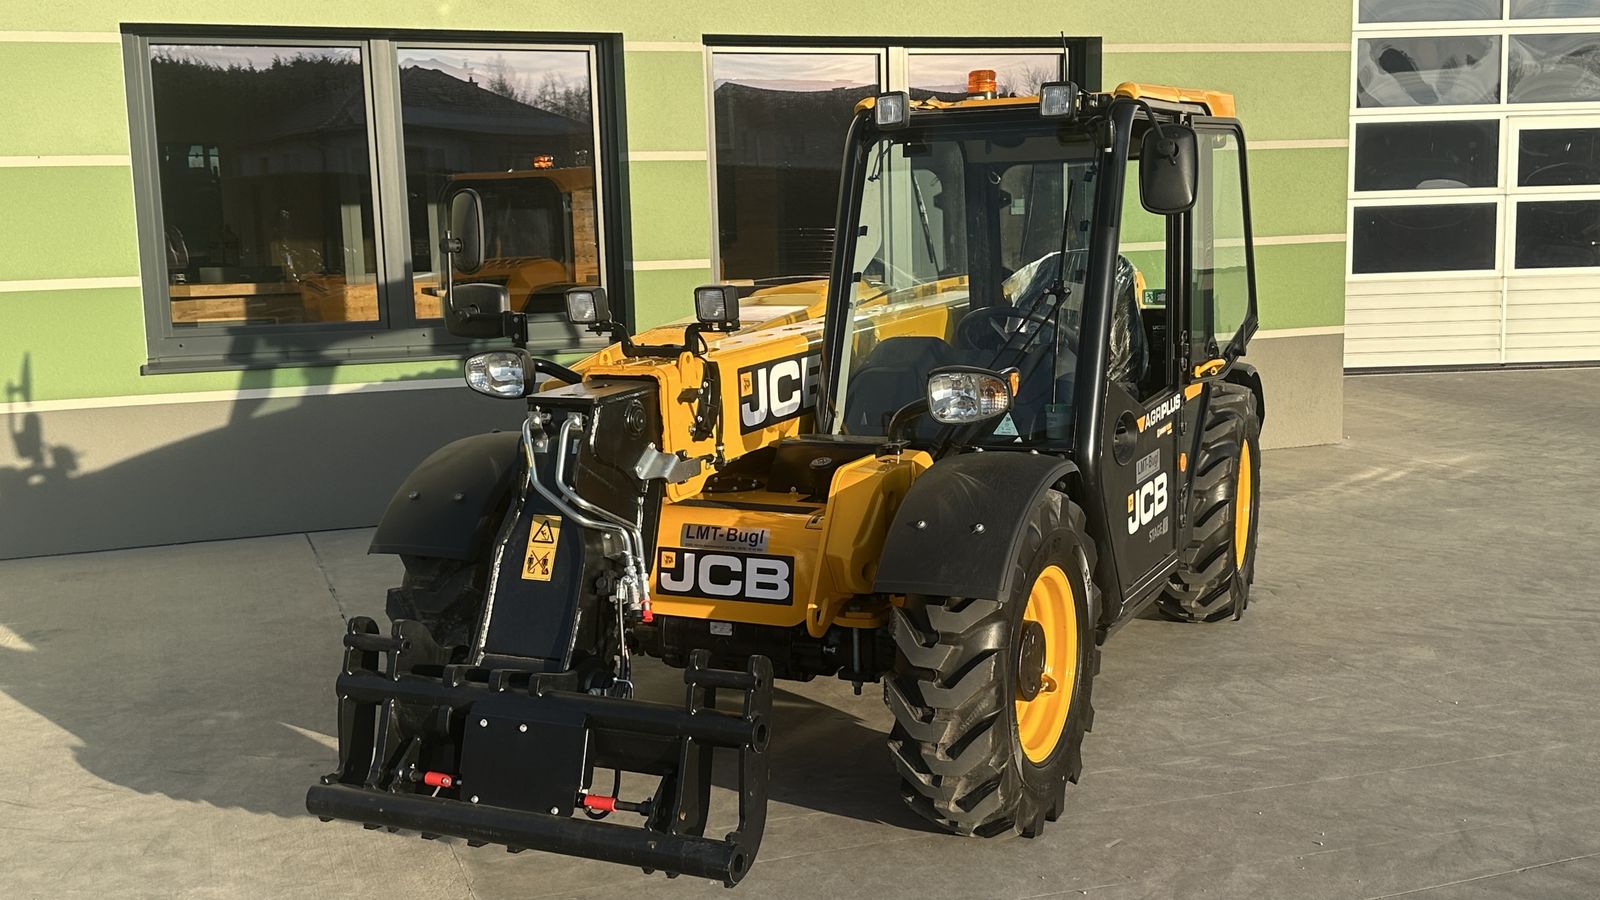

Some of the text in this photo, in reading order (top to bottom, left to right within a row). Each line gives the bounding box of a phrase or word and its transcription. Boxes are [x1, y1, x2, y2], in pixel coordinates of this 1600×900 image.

[741, 353, 820, 427] JCB
[1144, 393, 1181, 431] AGRIPLUS
[1127, 471, 1168, 535] JCB
[685, 525, 765, 548] LMT-Bugl
[660, 552, 790, 600] JCB
